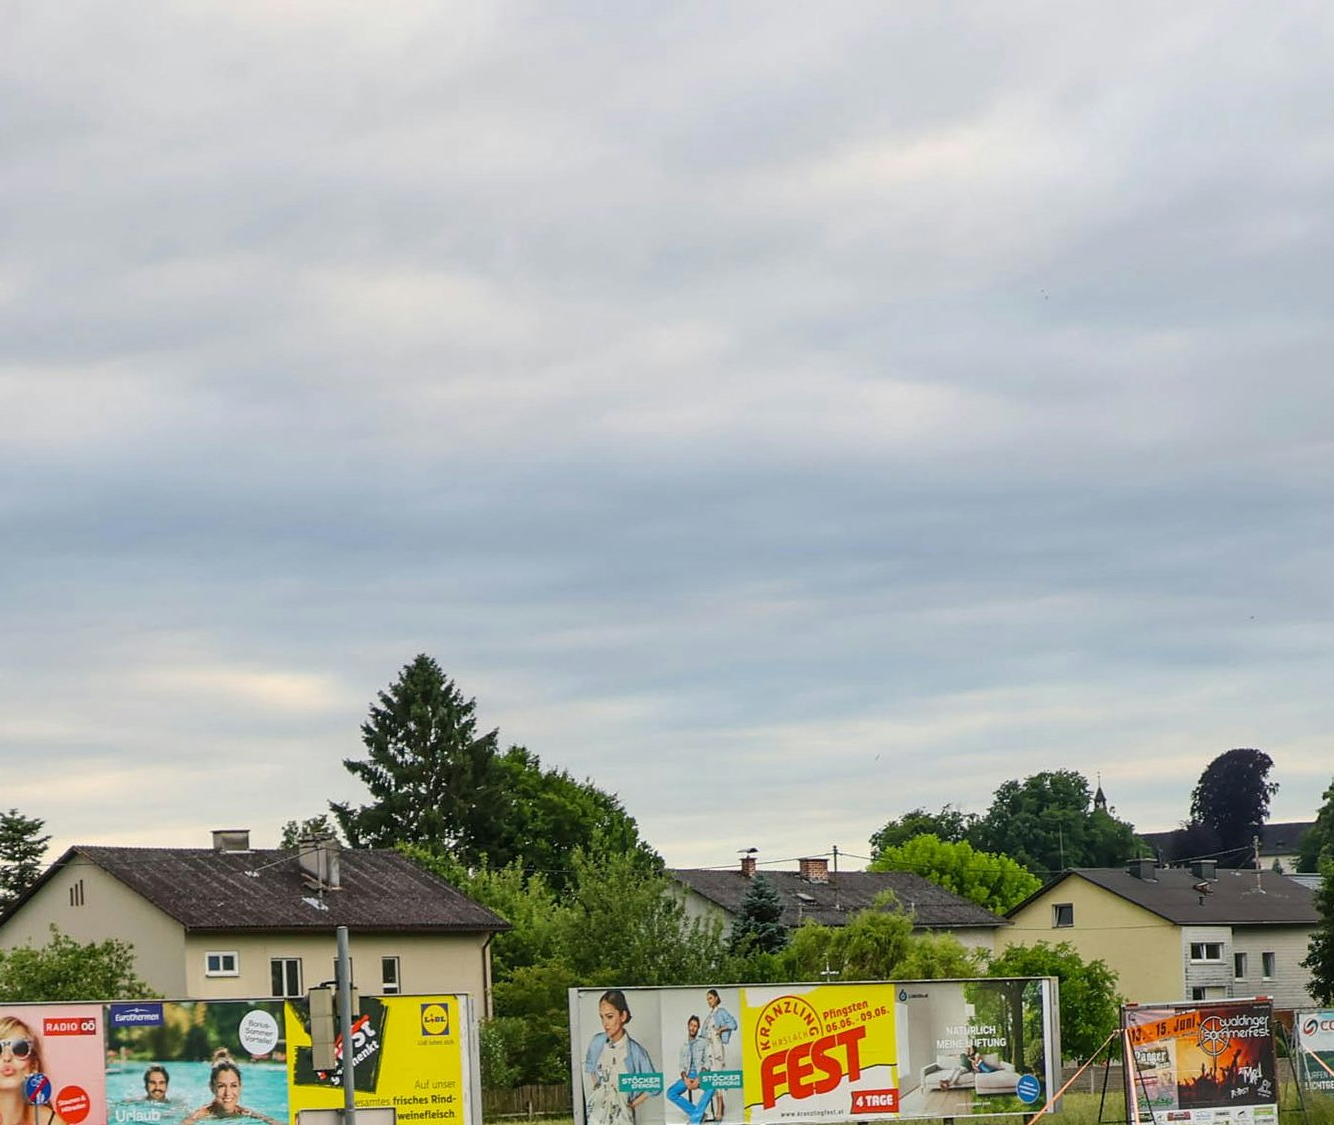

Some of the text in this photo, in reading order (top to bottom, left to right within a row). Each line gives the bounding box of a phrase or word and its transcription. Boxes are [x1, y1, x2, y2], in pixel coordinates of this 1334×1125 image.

[822, 1000, 869, 1021] Pfingsten
[759, 1001, 819, 1051] KRANZLING
[825, 1017, 856, 1033] 06.06.
[860, 1006, 891, 1022] 09.06.
[45, 1022, 78, 1032] RADIO
[244, 1027, 275, 1037] Sommer
[1131, 1028, 1147, 1043] 13.
[1155, 1023, 1171, 1035] 15.
[1173, 1015, 1197, 1032] Juni
[760, 1025, 867, 1110] FEST
[414, 1079, 456, 1089] Auf unser
[393, 1095, 429, 1105] frisches
[430, 1094, 457, 1104] Rind-
[856, 1094, 894, 1107] 4 TAGE
[115, 1109, 161, 1123] Urlaub
